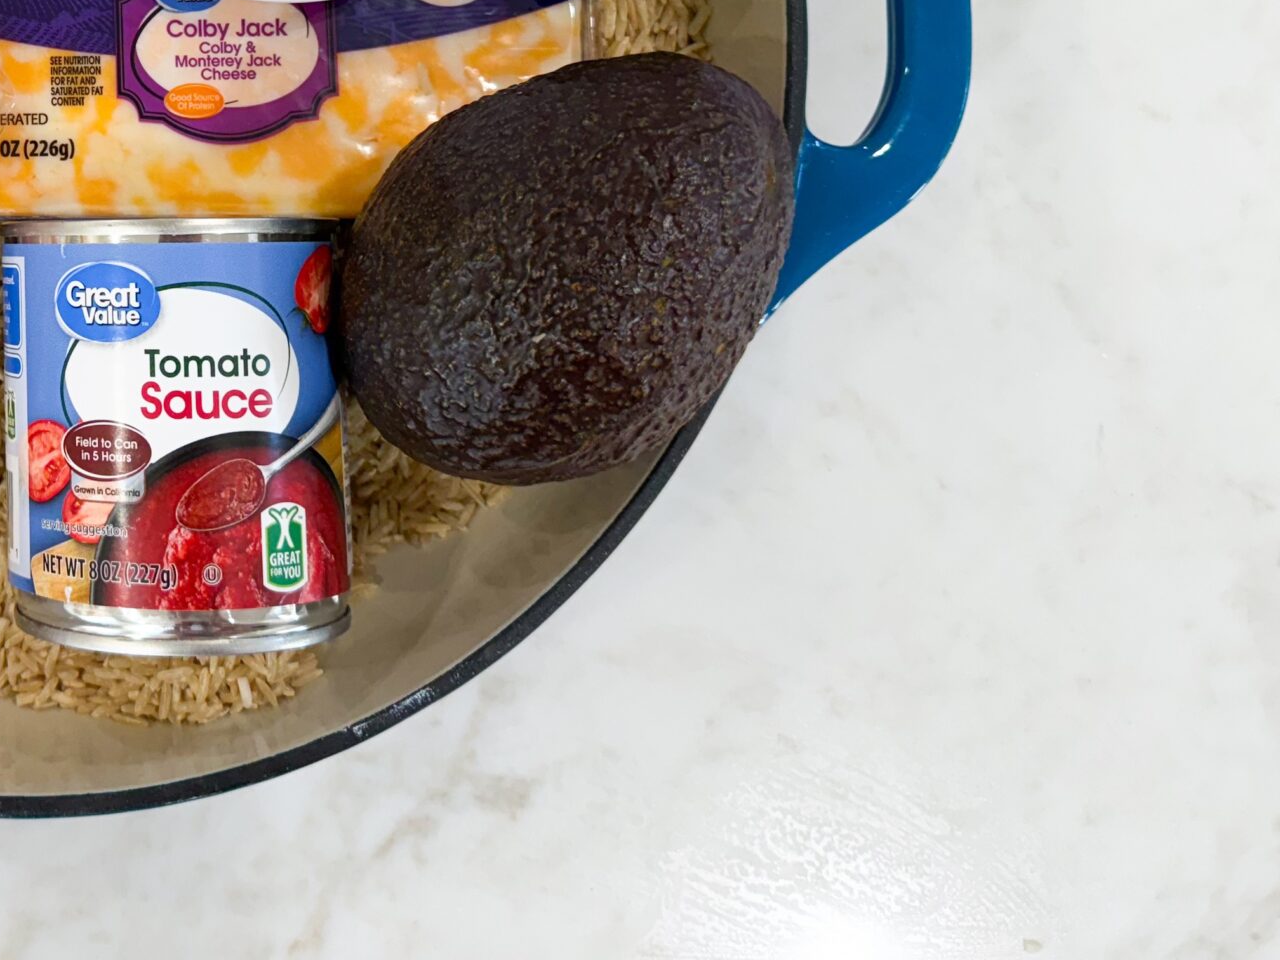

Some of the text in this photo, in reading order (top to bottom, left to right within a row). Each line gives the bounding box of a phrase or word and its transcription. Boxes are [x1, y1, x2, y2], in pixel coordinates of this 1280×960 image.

[166, 18, 288, 41] Colby Jack
[199, 41, 256, 56] Colby &
[50, 56, 101, 65] SEE NUTRITION
[175, 54, 282, 70] Monterey Jack
[50, 66, 101, 75] INFORMATION
[201, 68, 257, 80] Cheese
[51, 77, 96, 85] FOR FAT AND
[51, 86, 104, 96] SATURATED FAT
[51, 97, 85, 106] CONTENT
[169, 93, 219, 102] Good Source
[189, 102, 215, 110] Protein
[0, 141, 19, 157] OZ
[24, 139, 75, 160] (226g)
[66, 281, 140, 309] Great
[83, 306, 140, 326] Value
[144, 349, 270, 378] Tomato
[140, 381, 272, 419] Sauce
[75, 437, 138, 449] Field to Can
[81, 450, 132, 462] in 5 Hours
[74, 486, 95, 494] Grown
[41, 519, 128, 537] serving suggestion
[270, 551, 301, 566] GREAT
[43, 553, 178, 590] NET WT 8 OZ (227g)
[271, 566, 301, 578] FOR YOU
